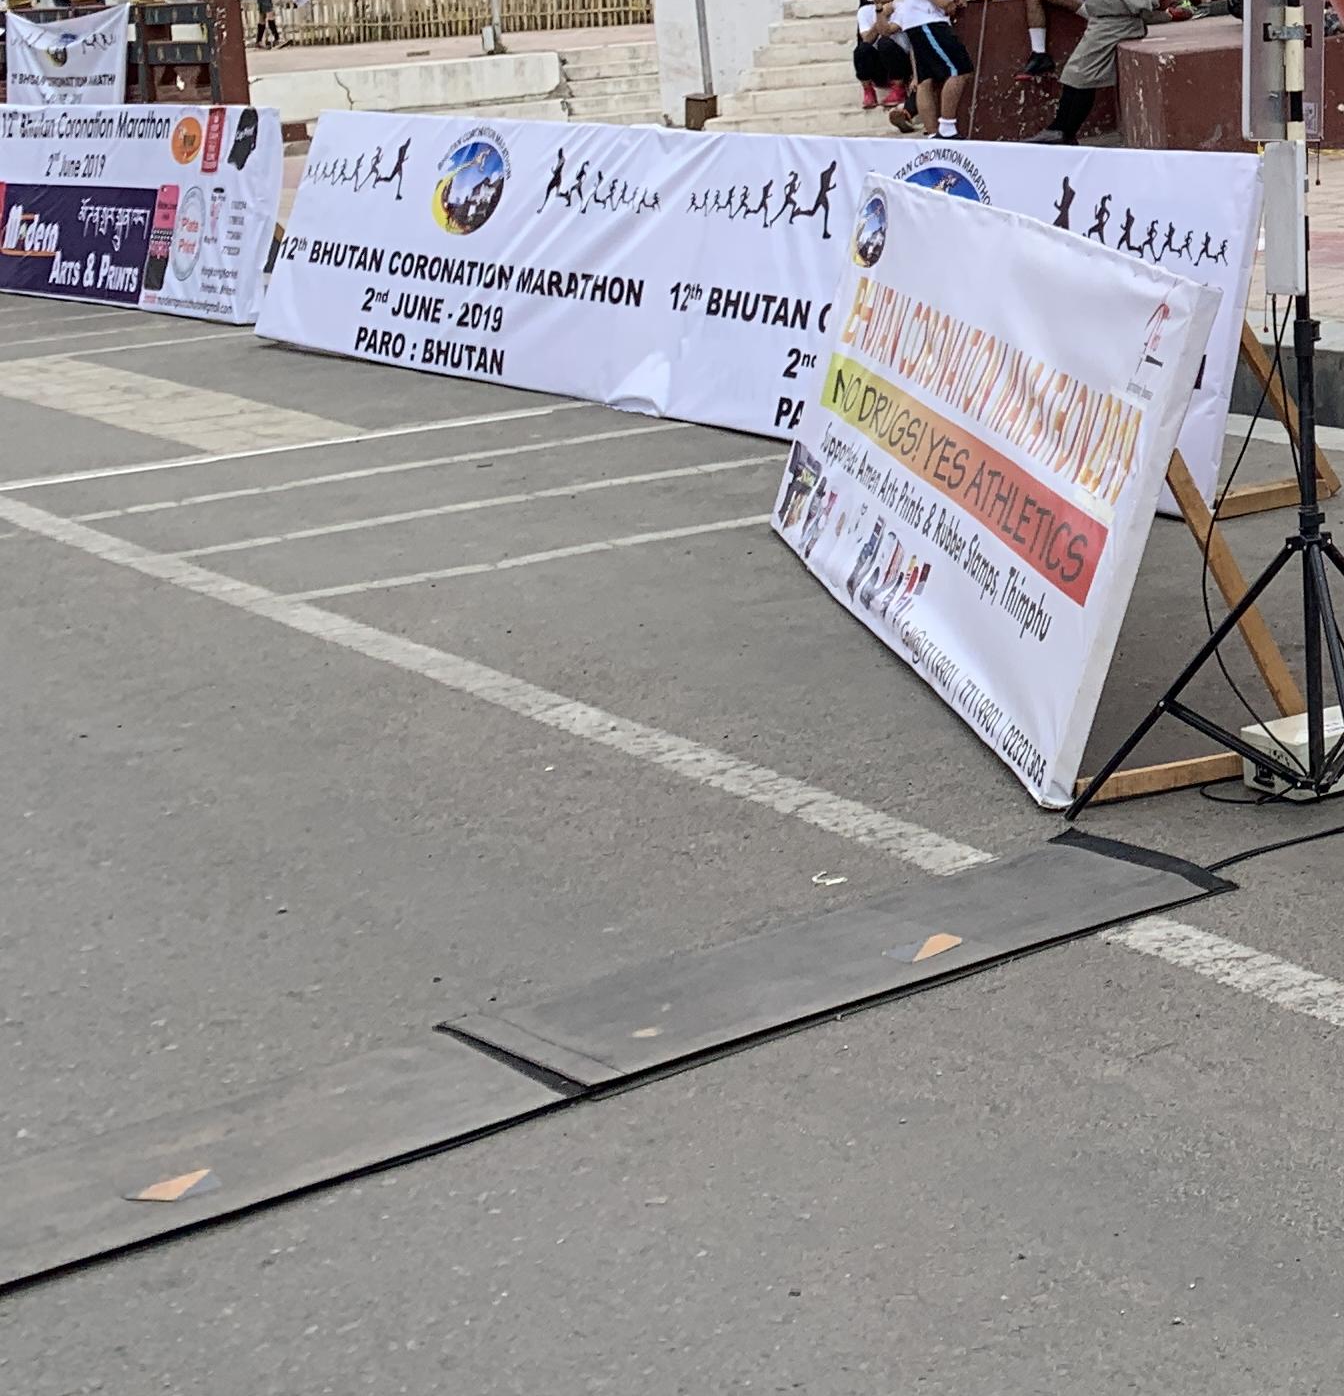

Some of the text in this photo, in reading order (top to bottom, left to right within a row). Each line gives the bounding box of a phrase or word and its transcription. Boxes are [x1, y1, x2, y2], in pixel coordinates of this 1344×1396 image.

[57, 111, 113, 139] Coronation
[115, 110, 171, 140] Marathon
[58, 153, 81, 178] June
[81, 153, 107, 179] 2019
[913, 148, 963, 168] CORONATION
[961, 157, 993, 206] MARATHO
[82, 251, 96, 288] &
[280, 235, 645, 308] 12th BHUTAN CORONATION MARATHON
[361, 286, 389, 313] 2nd
[391, 291, 445, 325] JUNE
[455, 301, 504, 333] 2019
[669, 281, 703, 312] 12th
[705, 287, 812, 331] BHUTAN
[354, 326, 406, 361] PARO
[421, 337, 506, 377] BHUTAN
[842, 276, 911, 368] BHUTAN
[898, 301, 1008, 422] CORONATION
[832, 368, 1090, 583] NO DRUGS! YES ATHLETICS
[855, 449, 882, 496] Amen
[876, 467, 899, 509] Arts
[894, 479, 925, 530] Prints
[921, 502, 937, 538] &
[931, 507, 967, 565] Rubber
[962, 533, 1001, 606] Stamps,
[999, 565, 1053, 642] Thimphu
